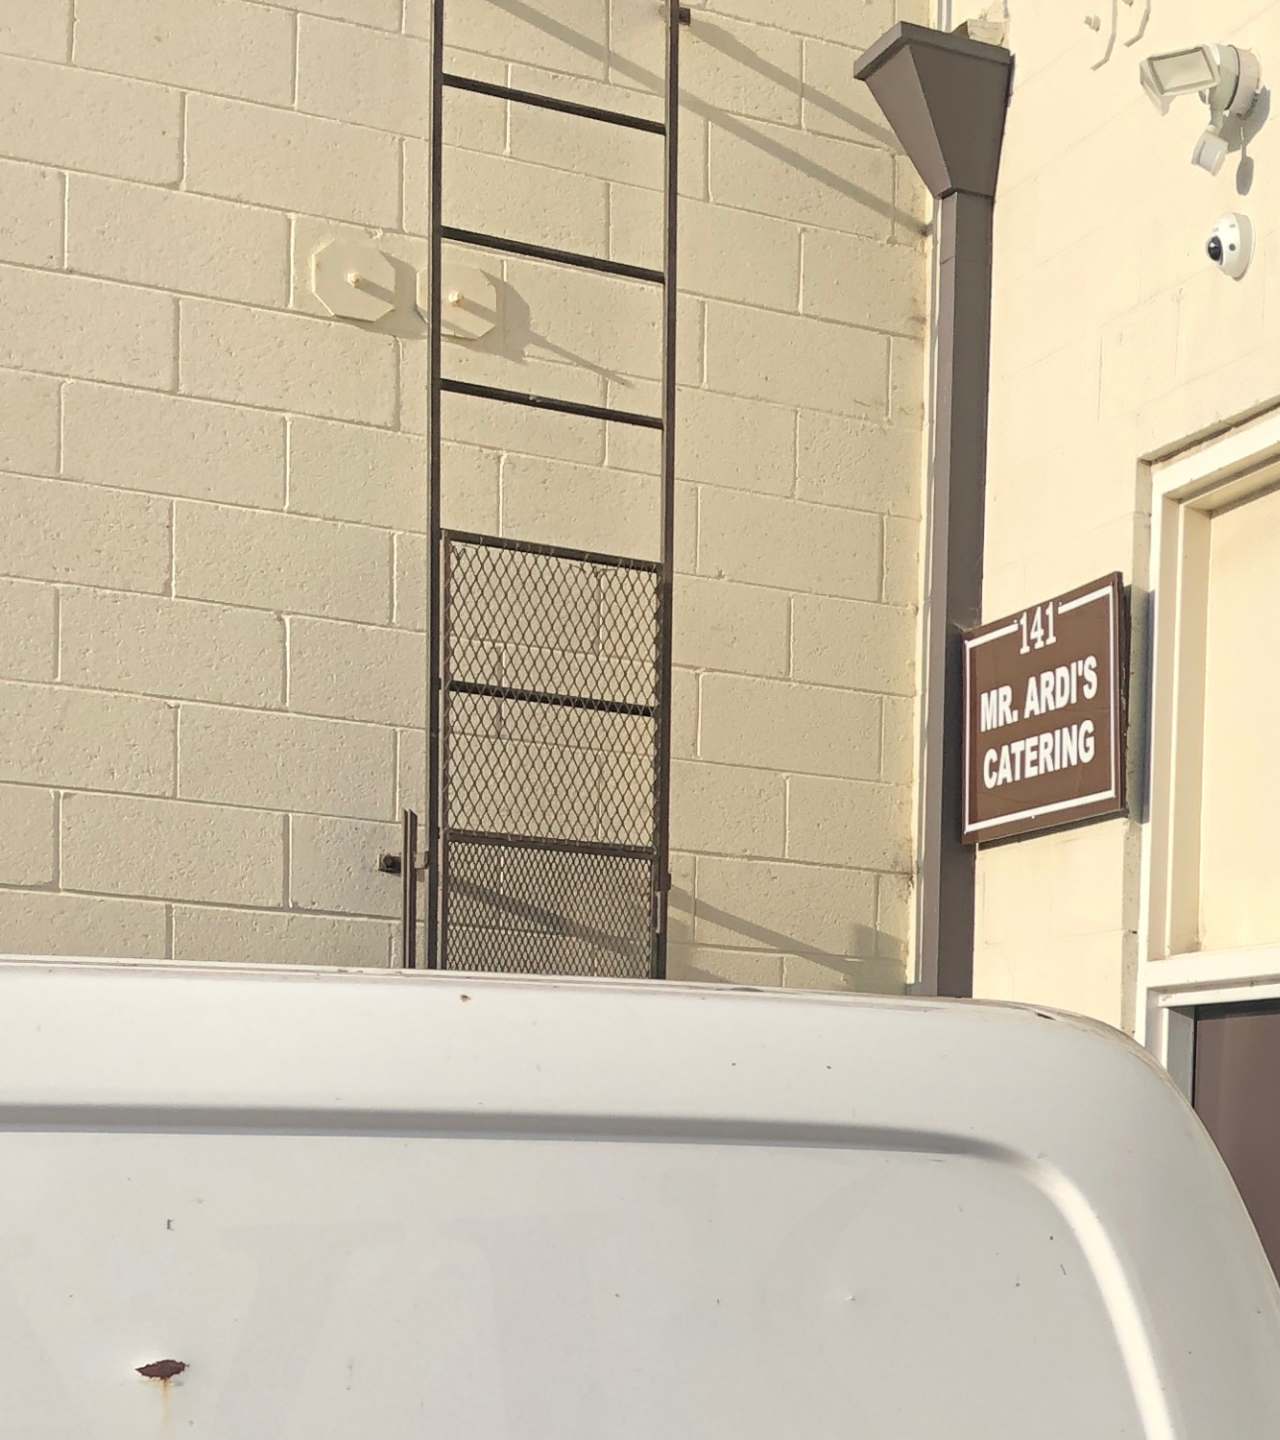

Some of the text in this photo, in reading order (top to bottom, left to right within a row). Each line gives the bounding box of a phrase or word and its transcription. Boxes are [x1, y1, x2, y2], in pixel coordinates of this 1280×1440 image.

[1018, 601, 1057, 655] 141
[980, 655, 1098, 732] MR. ARDI'S
[983, 719, 1095, 789] CATERING
